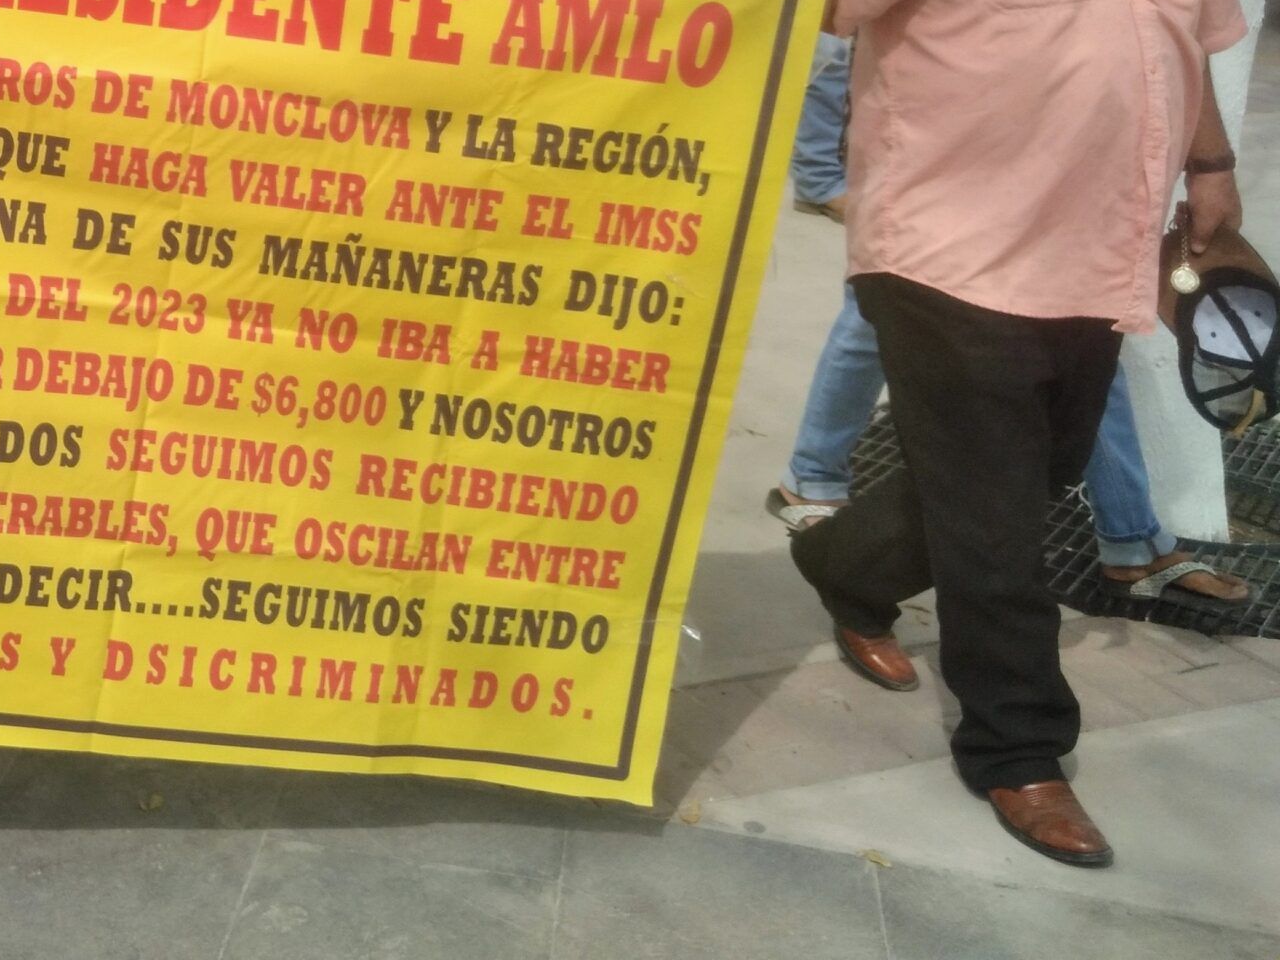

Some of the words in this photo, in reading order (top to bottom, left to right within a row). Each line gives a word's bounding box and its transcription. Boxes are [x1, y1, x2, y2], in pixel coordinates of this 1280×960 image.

[91, 70, 153, 118] DE
[166, 79, 412, 149] MONCLOVA
[425, 109, 452, 153] Y
[462, 114, 517, 162] LA
[531, 123, 710, 196] REGIÓN,
[89, 143, 207, 197] HAGA
[230, 160, 367, 216] VALER
[385, 180, 503, 231] ANTE
[521, 195, 573, 240] EL
[594, 203, 701, 255] IMSS
[73, 208, 136, 255] DE
[158, 220, 236, 268] SUS
[259, 233, 543, 306] MAÑANERAS
[564, 270, 684, 330] DIJO:
[5, 273, 88, 321] DEL
[109, 283, 207, 334] 2023
[226, 299, 275, 344] YA
[295, 307, 358, 353] NO
[378, 318, 452, 365] IBA
[471, 331, 500, 371] A
[520, 336, 670, 393] HABER
[13, 348, 173, 412] DEBAJO
[183, 364, 243, 410] DE
[252, 373, 386, 428] $6,800
[399, 389, 424, 430] Y
[430, 394, 656, 460] NOSOTROS
[107, 429, 333, 490] SEGUIMOS
[356, 455, 638, 524] RECIBIENDO
[196, 508, 277, 561] QUE
[295, 518, 472, 574] OSCILAN
[486, 540, 625, 589] ENTRE
[51, 637, 75, 676] Y
[103, 640, 592, 719] DSICRIMINADOS.
[447, 603, 609, 654] SIENDO
